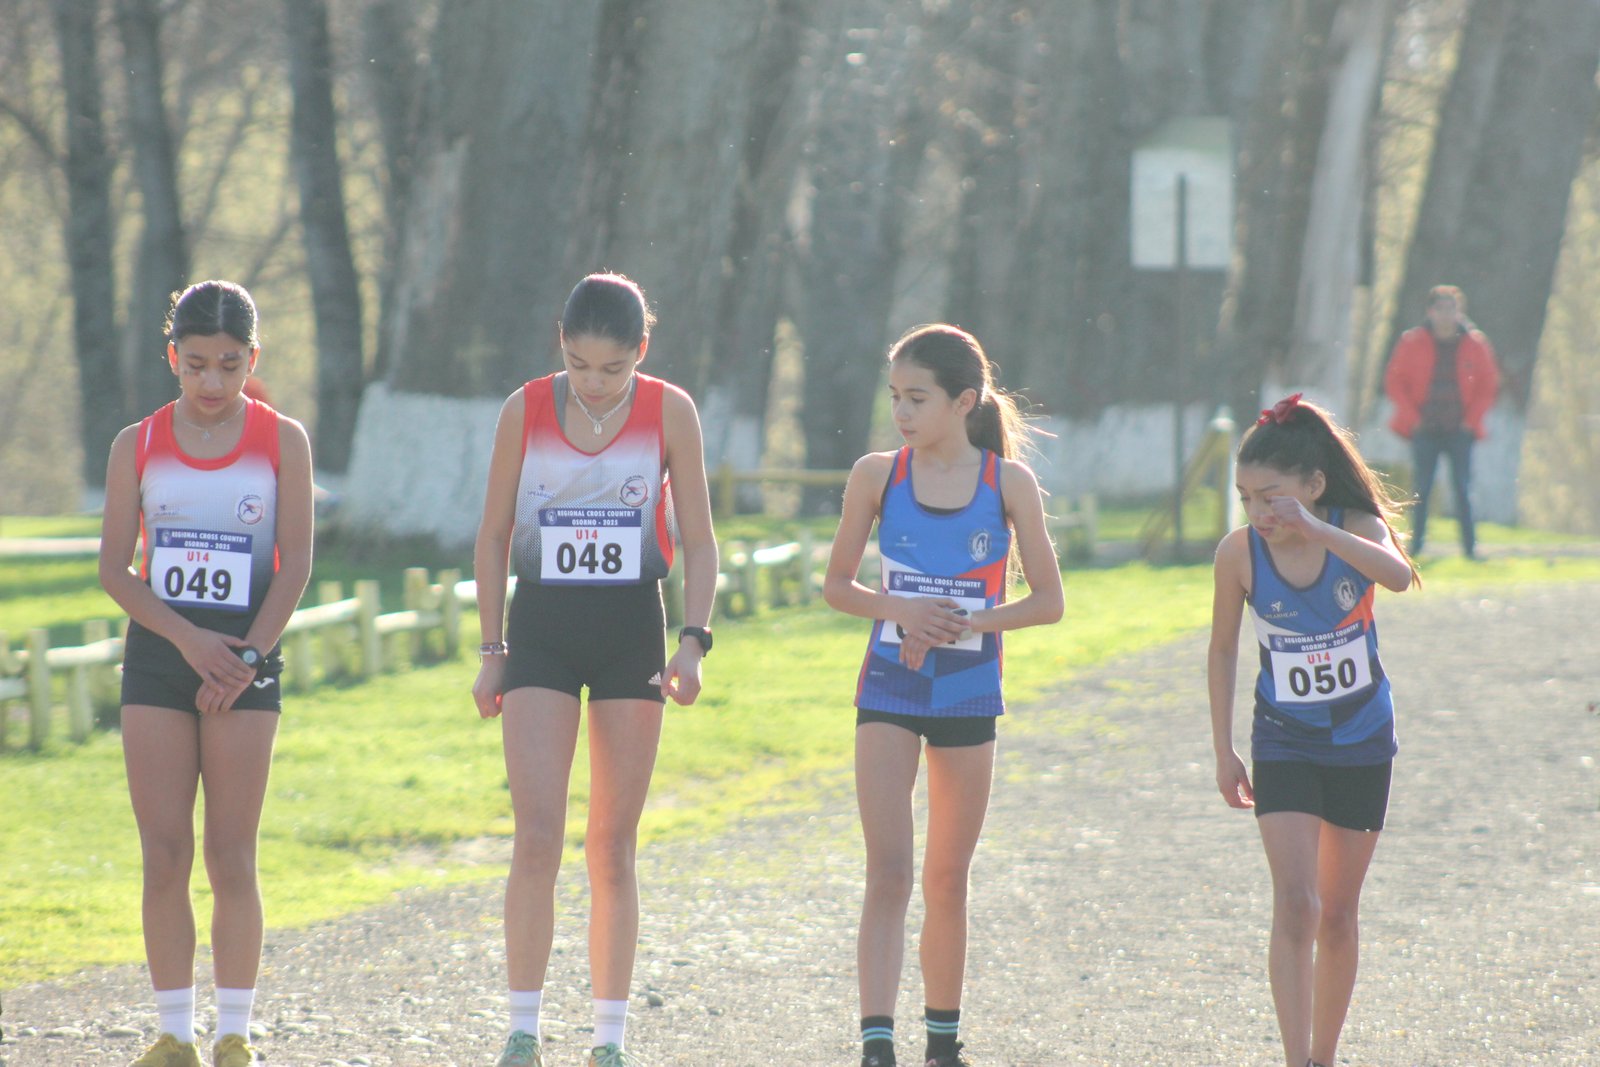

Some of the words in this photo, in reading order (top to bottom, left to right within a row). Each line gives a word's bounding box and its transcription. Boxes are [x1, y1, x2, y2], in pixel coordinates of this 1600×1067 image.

[171, 531, 198, 539] REGIONAL
[199, 532, 219, 541] CROSS
[219, 534, 247, 543] COUNTRY
[576, 529, 598, 540] U14
[184, 540, 209, 549] OSORNO
[187, 551, 209, 562] U14
[556, 542, 622, 574] 048
[164, 566, 232, 601] 049
[903, 574, 933, 584] REGIONAL
[934, 578, 954, 587] CROSS
[954, 580, 981, 589] COUNTRY
[918, 585, 944, 594] OSORNO
[1315, 632, 1335, 640] CROSS
[1335, 622, 1360, 636] COUNTRY
[1301, 643, 1327, 651] OSORNO
[1307, 651, 1331, 665] U14
[1288, 657, 1357, 697] 050
